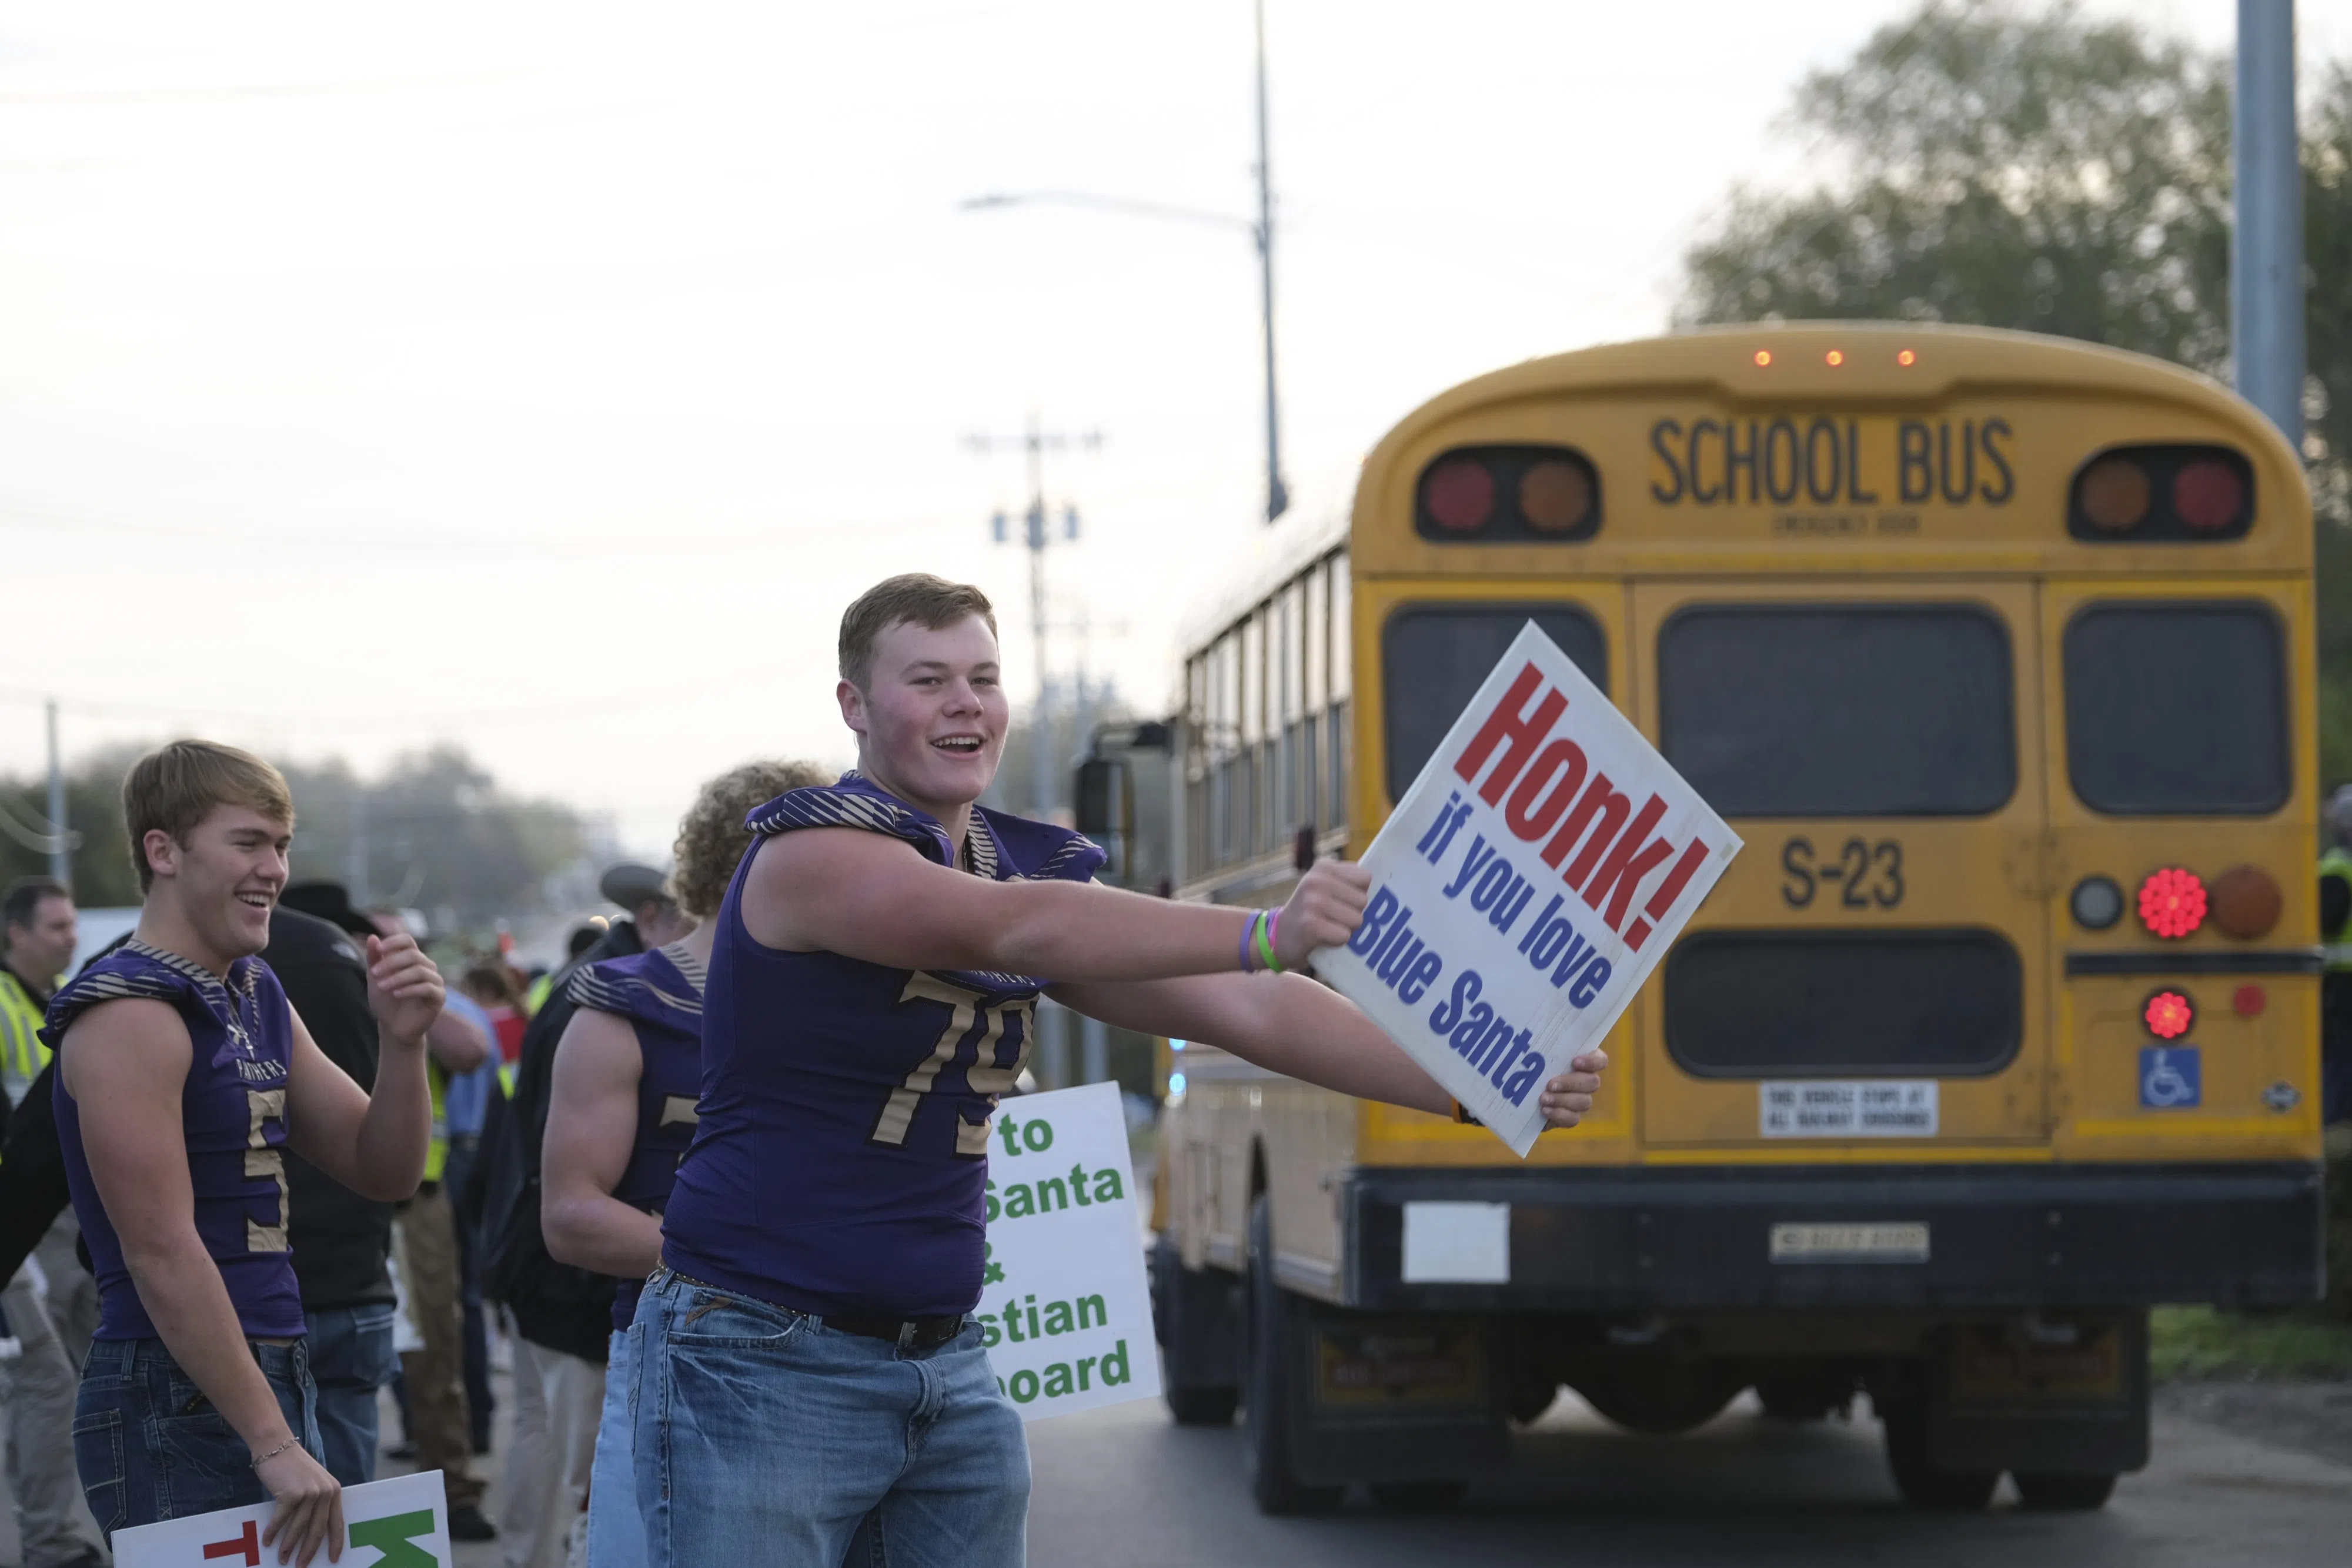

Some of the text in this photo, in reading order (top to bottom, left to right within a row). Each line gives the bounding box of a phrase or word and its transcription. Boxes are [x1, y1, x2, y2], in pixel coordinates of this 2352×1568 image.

[1651, 417, 2015, 505] SCHOOL BUS
[1454, 661, 1709, 954] Honk!
[1415, 790, 1613, 1009] if you love
[1780, 835, 1906, 910] S-23
[1345, 884, 1546, 1109] Blue Santa
[872, 969, 1040, 1155] 79
[997, 1113, 1054, 1157] to
[996, 1339, 1131, 1403] oard
[203, 1520, 260, 1567] T
